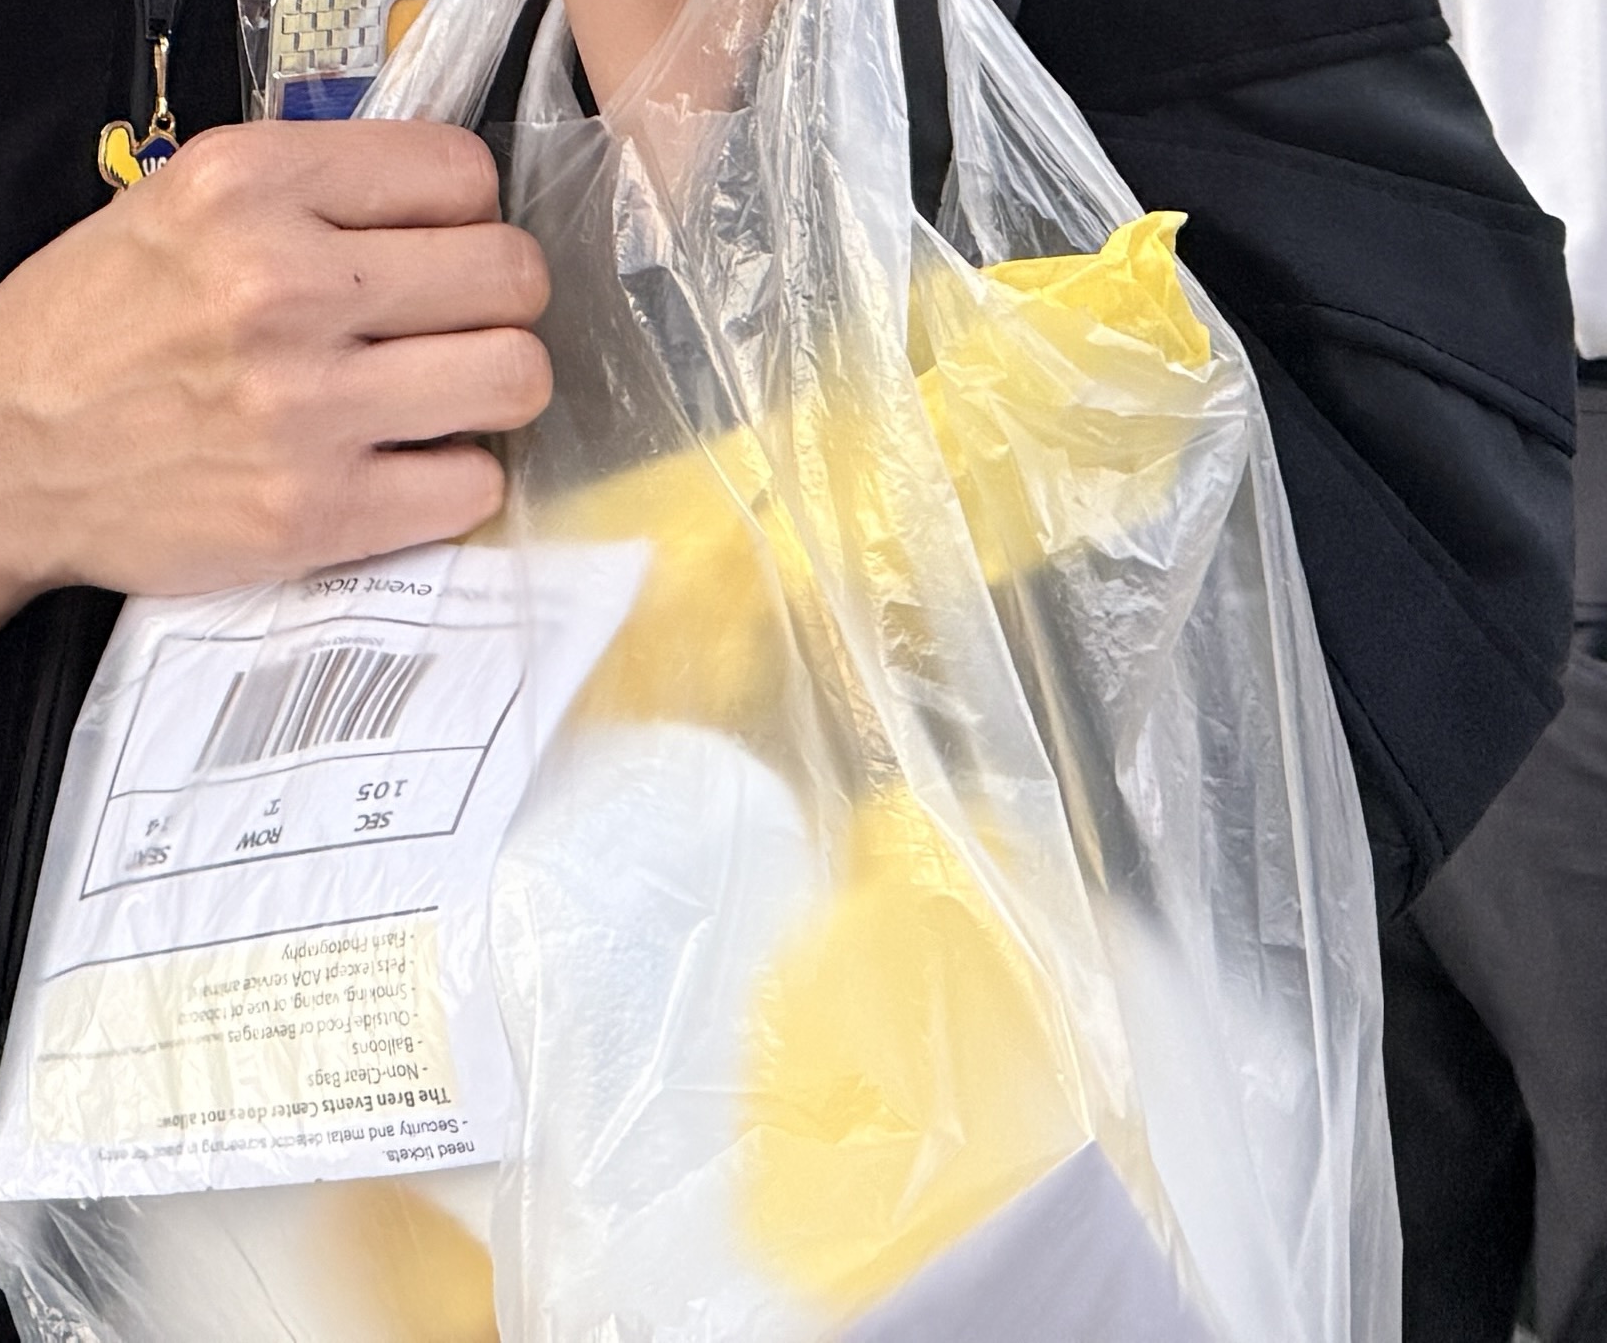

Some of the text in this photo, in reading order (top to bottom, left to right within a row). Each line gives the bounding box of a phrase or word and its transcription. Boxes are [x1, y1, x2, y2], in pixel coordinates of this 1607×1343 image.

[363, 578, 433, 599] event
[355, 779, 409, 801] 105
[262, 799, 282, 816] T
[354, 811, 394, 831] SEC
[235, 825, 283, 850] ROW
[246, 1001, 271, 1017] use
[274, 1000, 287, 1012] or
[227, 1022, 296, 1045] Beverages
[299, 1021, 313, 1034] or
[317, 1017, 352, 1034] Food
[351, 1037, 414, 1056] Balloons
[306, 1063, 419, 1088] Non-Clear Bags
[322, 1095, 372, 1115] Events
[376, 1091, 414, 1110] Bren
[418, 1087, 451, 1106] The
[200, 1111, 225, 1125] not
[229, 1106, 267, 1124] does
[271, 1101, 319, 1119] Center
[327, 1129, 364, 1145] metal
[368, 1125, 395, 1141] and
[399, 1117, 459, 1139] Security
[382, 1140, 475, 1163] need tickets.
